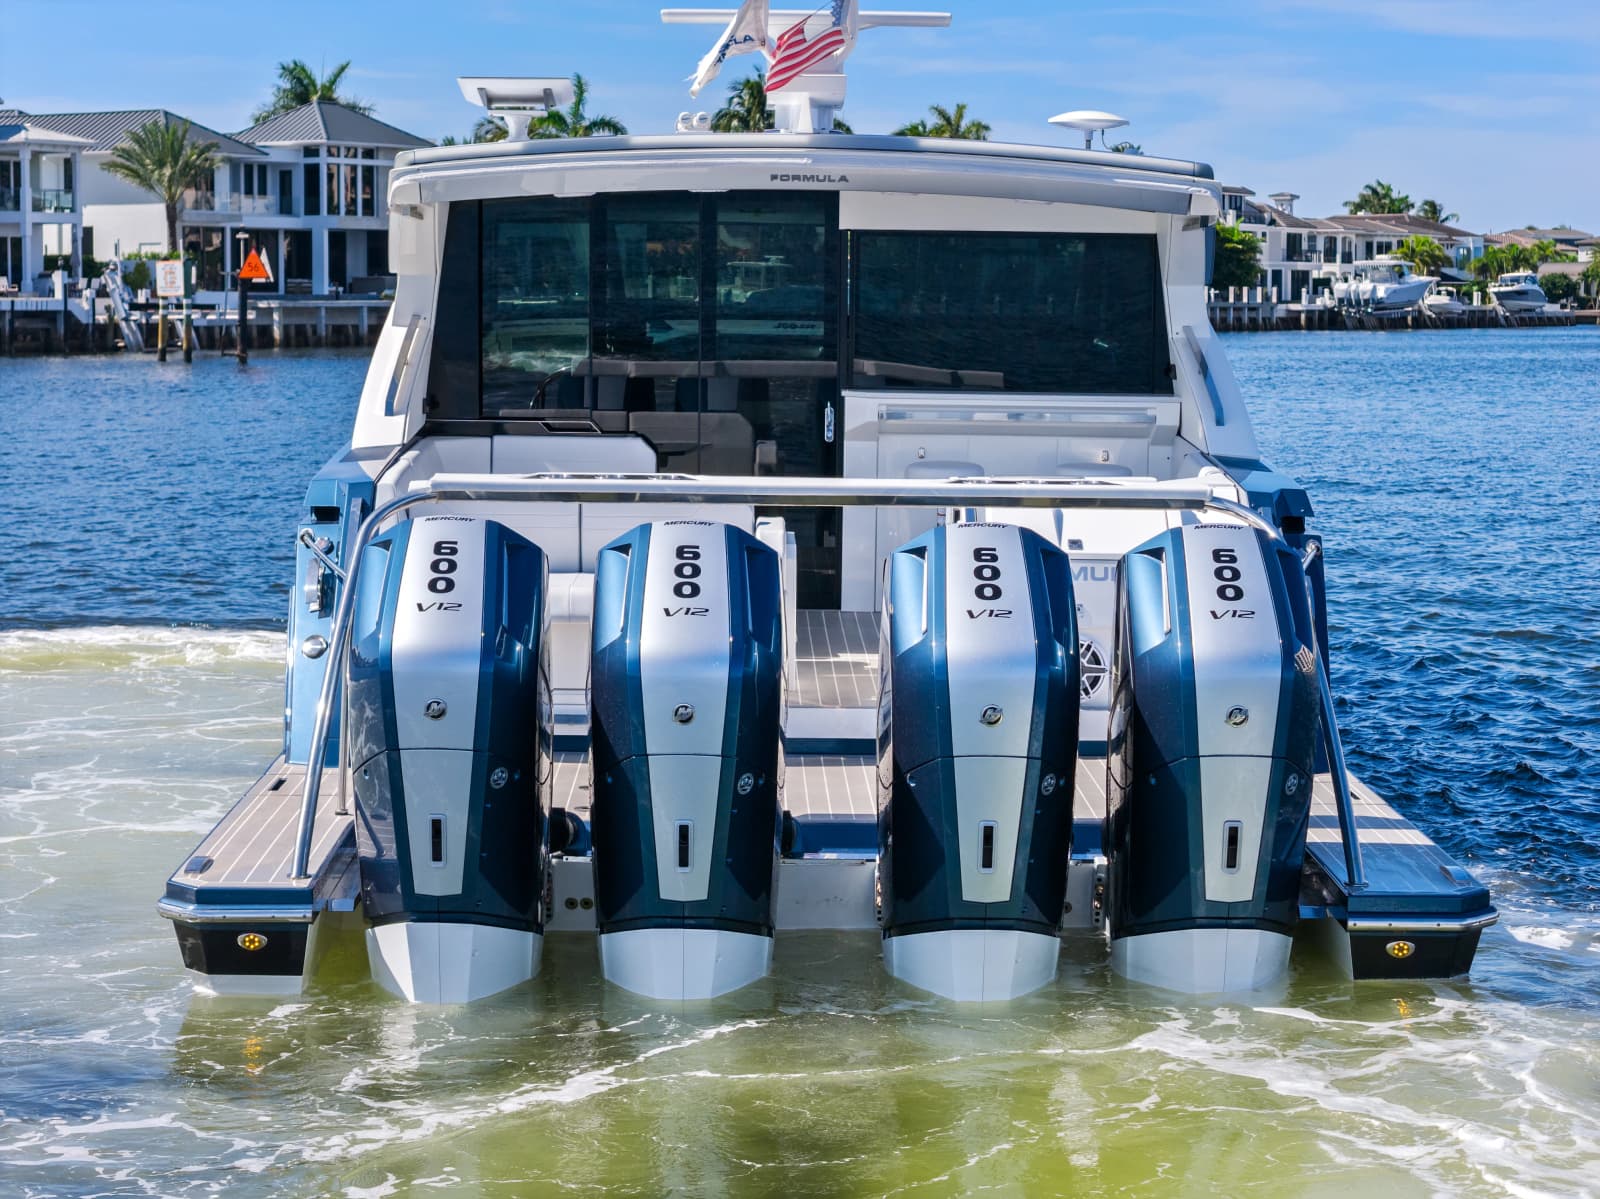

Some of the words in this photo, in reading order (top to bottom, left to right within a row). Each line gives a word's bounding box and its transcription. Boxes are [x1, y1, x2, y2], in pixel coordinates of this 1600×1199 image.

[770, 173, 849, 184] FORMULA
[424, 514, 476, 522] MERCURY
[427, 540, 459, 594] 600
[673, 545, 702, 599] 600
[973, 547, 1002, 601] 600
[1072, 566, 1117, 581] MU
[1212, 548, 1244, 602] 600
[416, 602, 463, 612] V12
[663, 607, 710, 617] V12
[966, 609, 1013, 619] V12
[1209, 609, 1256, 620] V12
